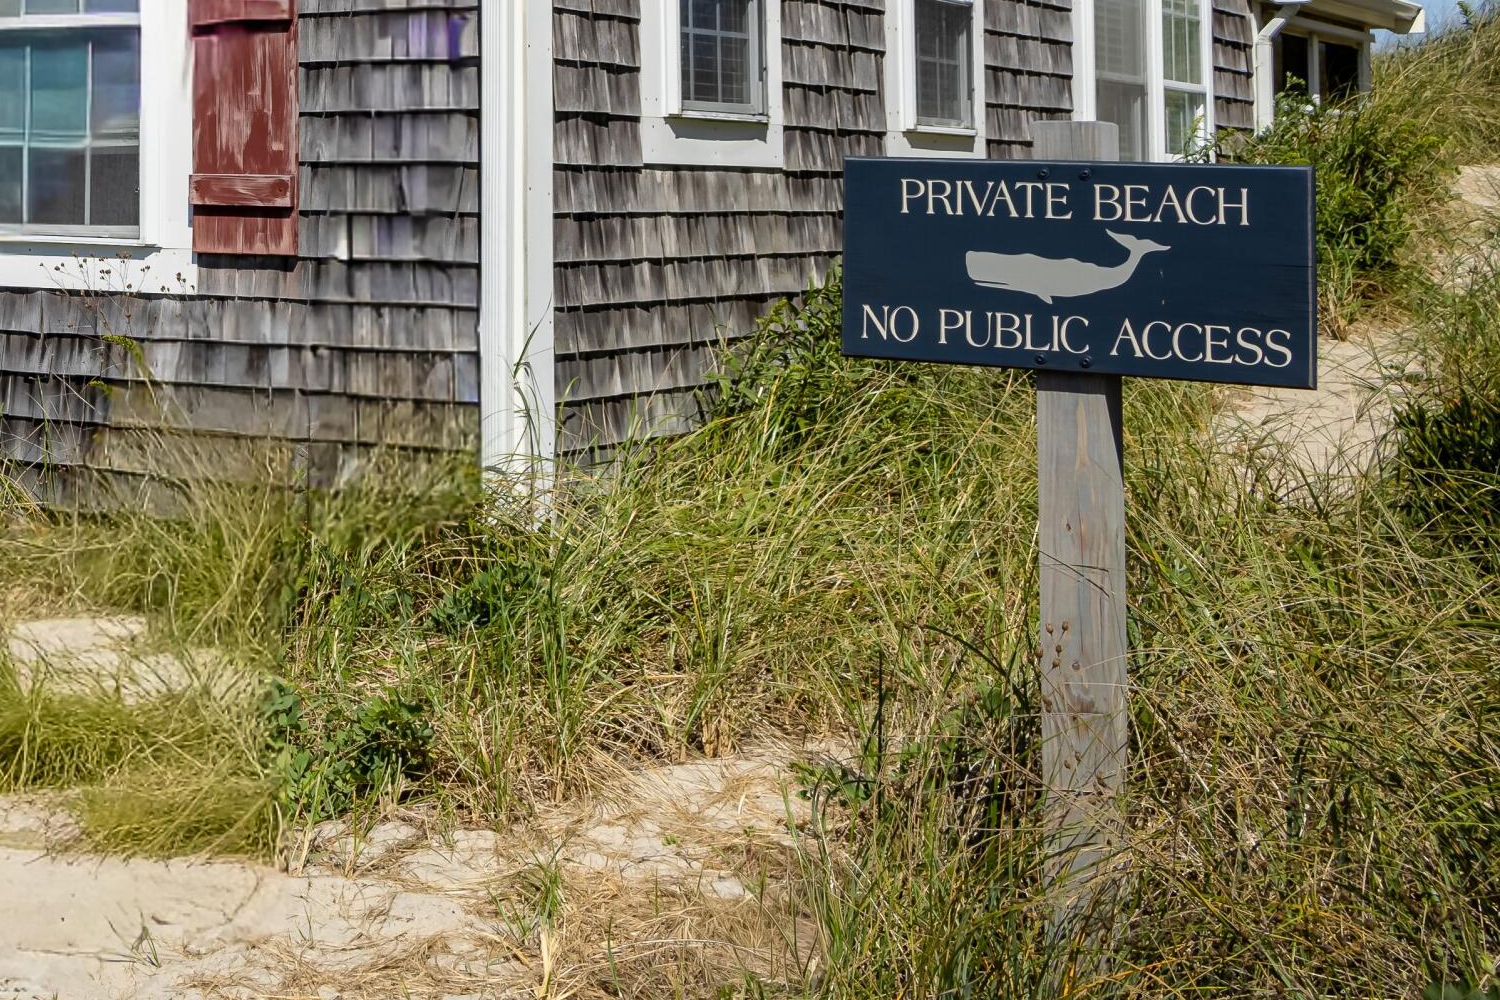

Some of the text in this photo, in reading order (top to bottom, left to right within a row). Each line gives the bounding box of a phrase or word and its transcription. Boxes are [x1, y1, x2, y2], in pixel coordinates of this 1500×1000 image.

[900, 178, 1250, 226] PRIVATE BEACH
[861, 304, 1292, 368] NO PUBLIC ACCESS
